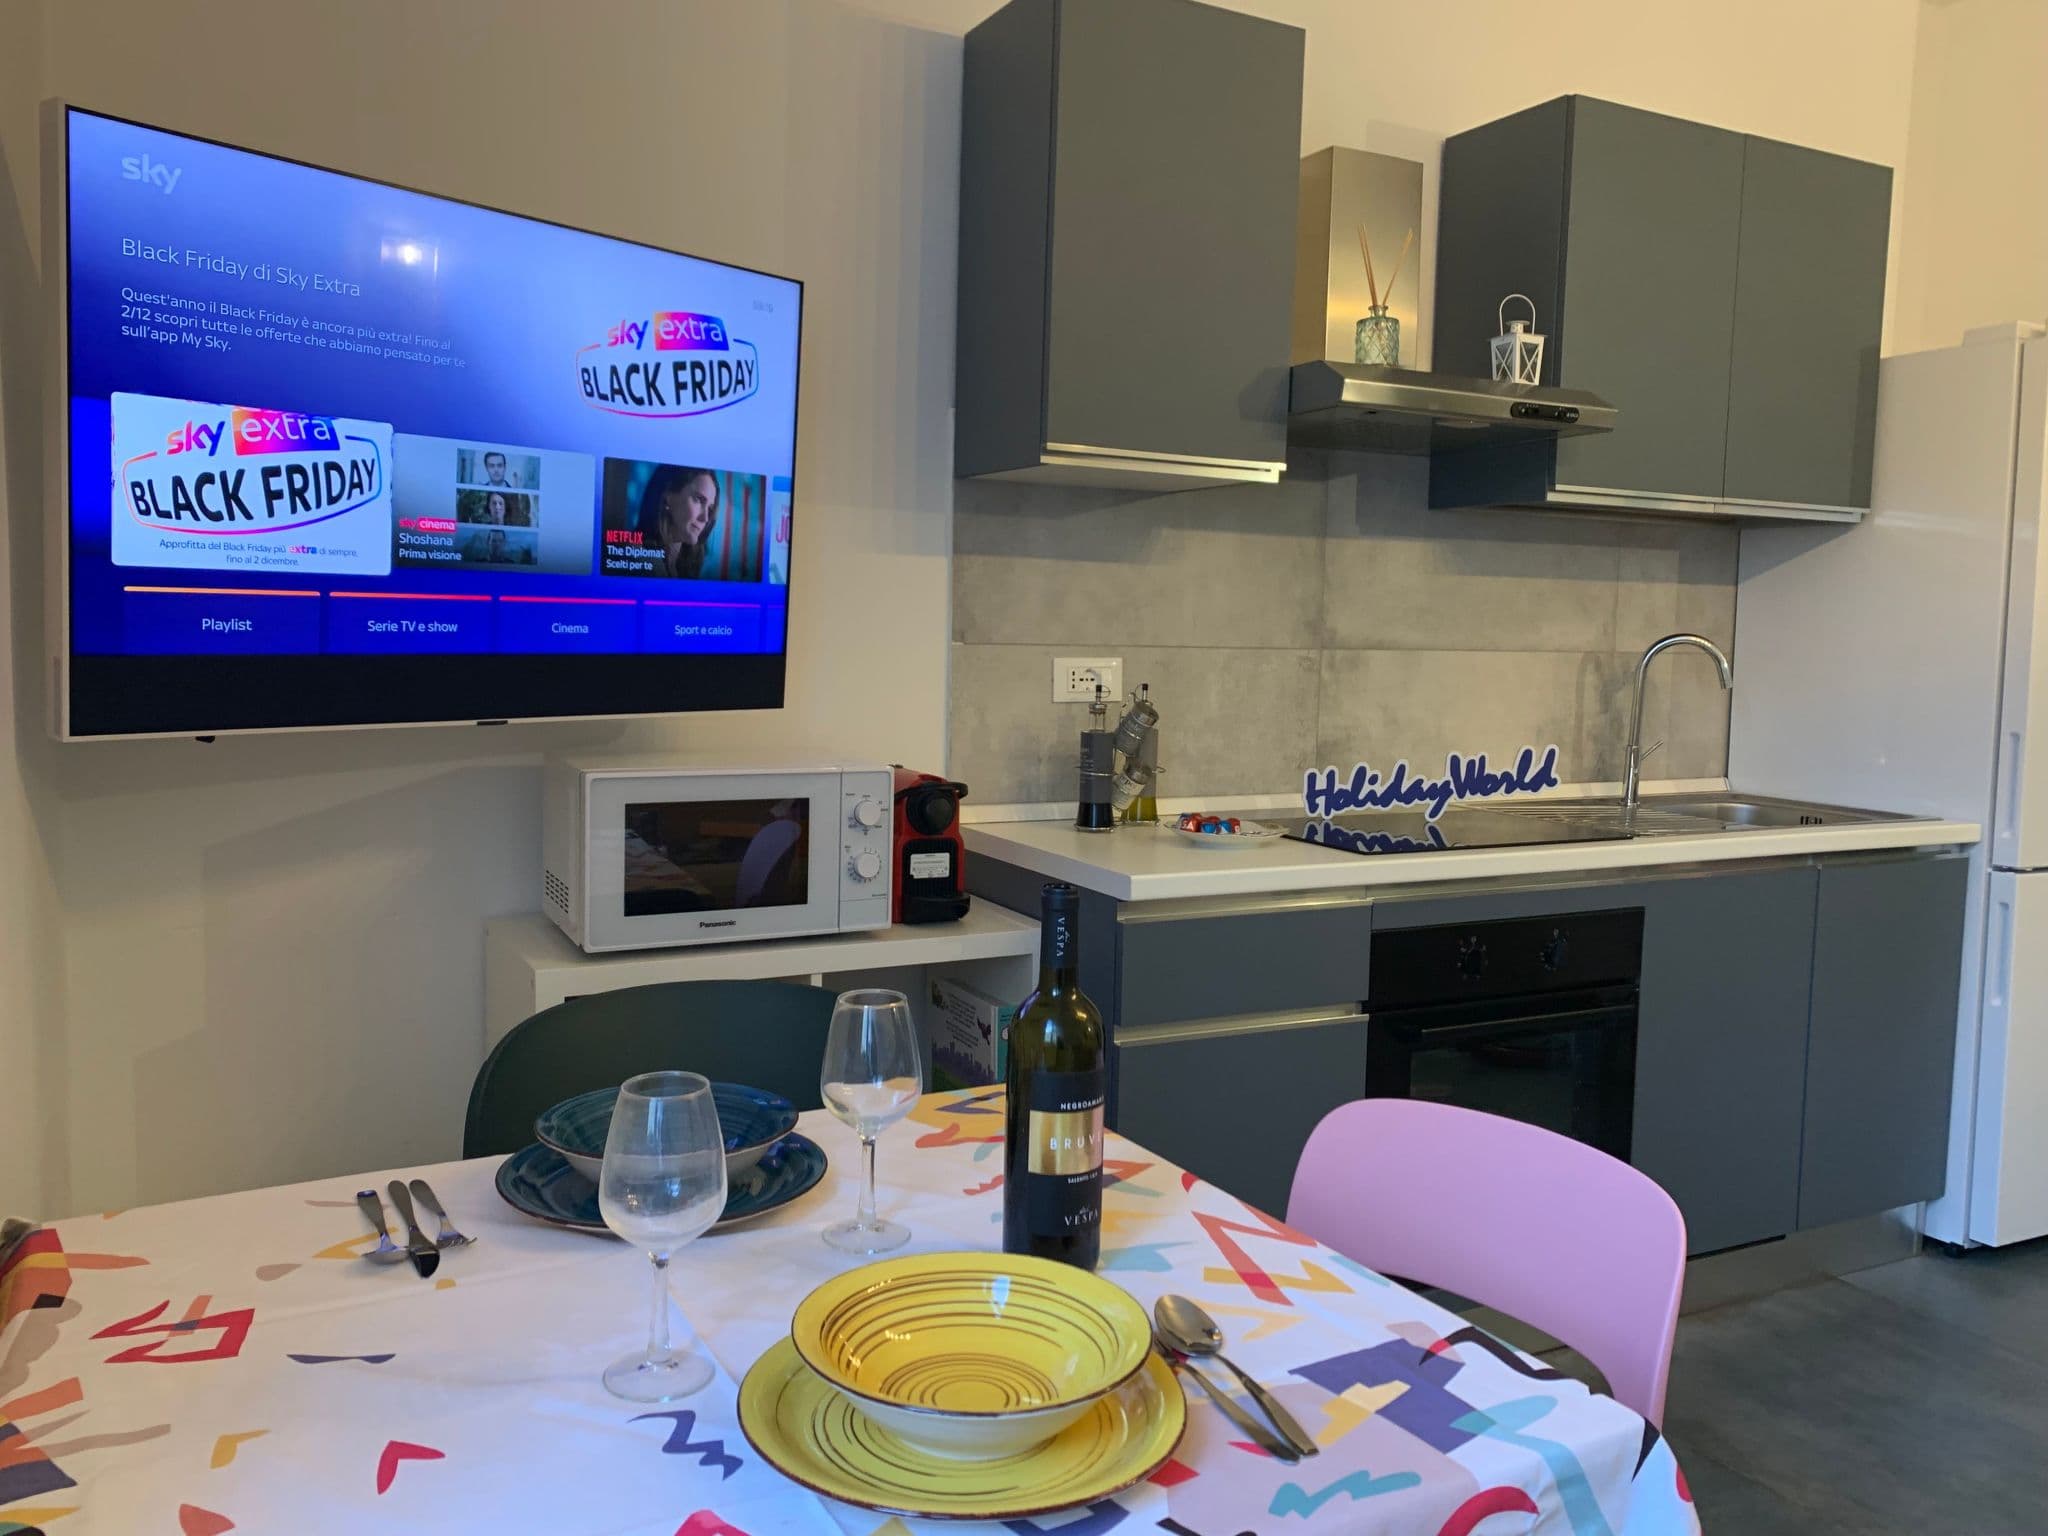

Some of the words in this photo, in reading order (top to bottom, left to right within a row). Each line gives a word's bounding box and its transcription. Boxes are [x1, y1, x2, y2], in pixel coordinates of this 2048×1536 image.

[121, 153, 182, 194] sky
[122, 238, 180, 265] Black
[186, 249, 248, 281] Friday
[253, 263, 271, 281] di
[276, 266, 309, 291] Sky
[314, 273, 360, 297] Extra
[121, 287, 206, 312] Quest'anno
[209, 301, 217, 314] il
[220, 303, 256, 319] Black
[259, 309, 299, 328] Friday
[301, 316, 310, 328] è
[312, 320, 354, 335] ancora
[357, 327, 376, 339] più
[378, 331, 412, 344] extra!
[415, 335, 439, 349] Fino
[441, 339, 451, 350] al
[121, 305, 151, 320] 2/12
[154, 312, 198, 328] scopri
[202, 318, 238, 334] tutte
[240, 323, 252, 336] le
[255, 327, 301, 344] offerte
[304, 335, 327, 348] che
[329, 339, 381, 355] abbiamo
[384, 347, 431, 363] pensato
[433, 354, 451, 366] per
[454, 358, 466, 368] te
[121, 325, 178, 344] sull'app
[182, 332, 202, 349] My
[205, 335, 232, 352] Sky.
[607, 320, 649, 350] sky
[659, 315, 723, 342] extra
[581, 361, 666, 406] BLACK
[672, 359, 755, 406] FRIDAY
[167, 420, 226, 456] sky
[240, 412, 331, 443] extra
[130, 468, 254, 522] BLACK
[260, 458, 376, 518] FRIDAY
[419, 518, 456, 531] cinema
[399, 533, 453, 546] Shoshana
[606, 530, 643, 544] NETFLIX
[160, 539, 206, 550] Approfitta
[208, 541, 221, 550] del
[223, 542, 245, 551] Black
[247, 544, 272, 554] Friday
[288, 545, 318, 554] extra
[319, 547, 326, 555] di
[399, 548, 427, 560] Prima
[428, 549, 462, 561] visione
[607, 545, 624, 556] The
[625, 546, 665, 559] Diplomat
[226, 554, 243, 564] fino
[245, 555, 252, 564] al
[254, 556, 259, 564] 2
[606, 559, 629, 569] Scelti
[630, 560, 642, 571] per
[644, 560, 654, 570] te
[202, 618, 252, 633] Playlist
[367, 619, 399, 632] Serie
[400, 620, 416, 632] TV
[418, 623, 426, 632] e
[427, 620, 458, 632] show
[551, 622, 589, 634] Cinema
[674, 624, 699, 637] Sport
[700, 626, 707, 634] e
[707, 625, 733, 635] calcio
[699, 920, 737, 928] Panasonic
[1056, 916, 1066, 957] VESPA
[1064, 1207, 1099, 1227] VESPA
